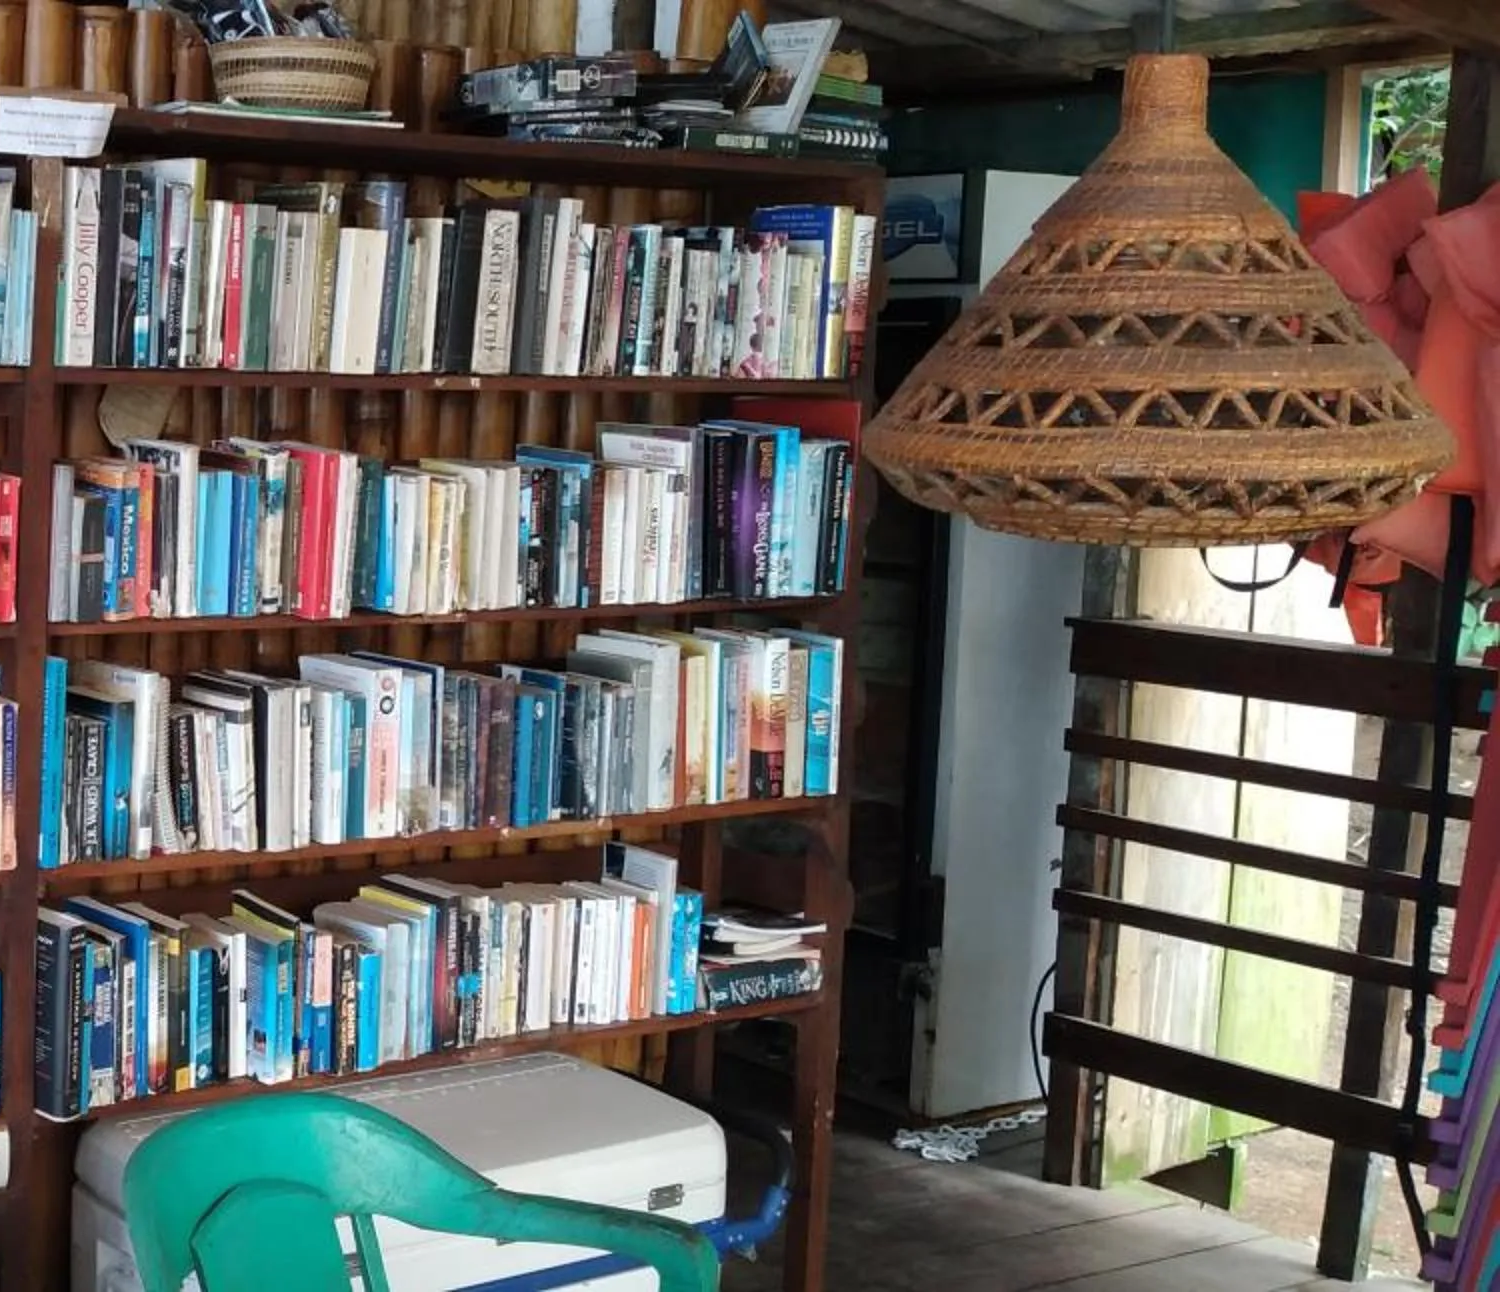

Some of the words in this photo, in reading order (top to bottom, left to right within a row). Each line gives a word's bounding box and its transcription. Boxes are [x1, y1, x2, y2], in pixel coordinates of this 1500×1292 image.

[77, 221, 96, 257] Jilly
[856, 229, 873, 268] Nelson
[73, 261, 95, 331] Cooper
[483, 289, 502, 353] SOUTH
[834, 451, 846, 477] Nora
[832, 479, 844, 519] Roberts
[121, 504, 134, 575] Mexico
[770, 650, 788, 689] Nelson
[84, 734, 99, 777] CRAVE
[85, 785, 100, 828] WARD
[729, 976, 769, 1005] KING
